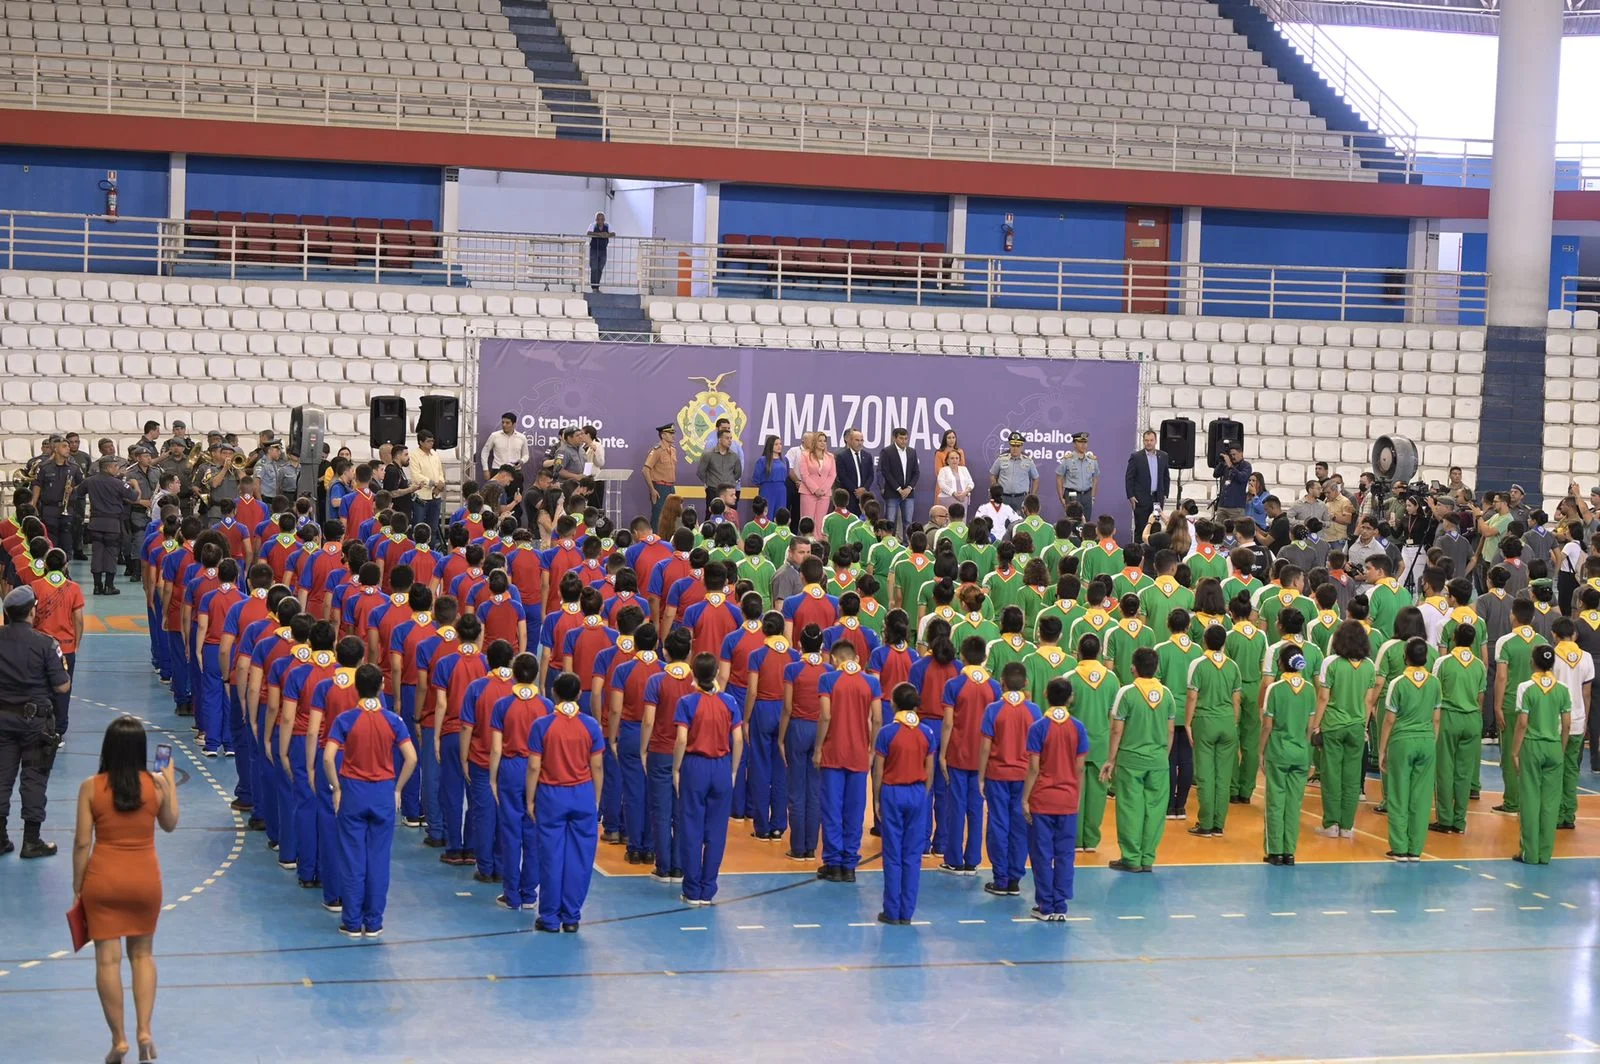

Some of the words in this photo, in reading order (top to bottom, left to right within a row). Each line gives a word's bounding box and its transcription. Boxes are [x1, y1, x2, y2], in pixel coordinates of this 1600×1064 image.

[521, 415, 536, 429] O
[538, 415, 603, 430] trabalho
[758, 392, 954, 450] AMAZONAS
